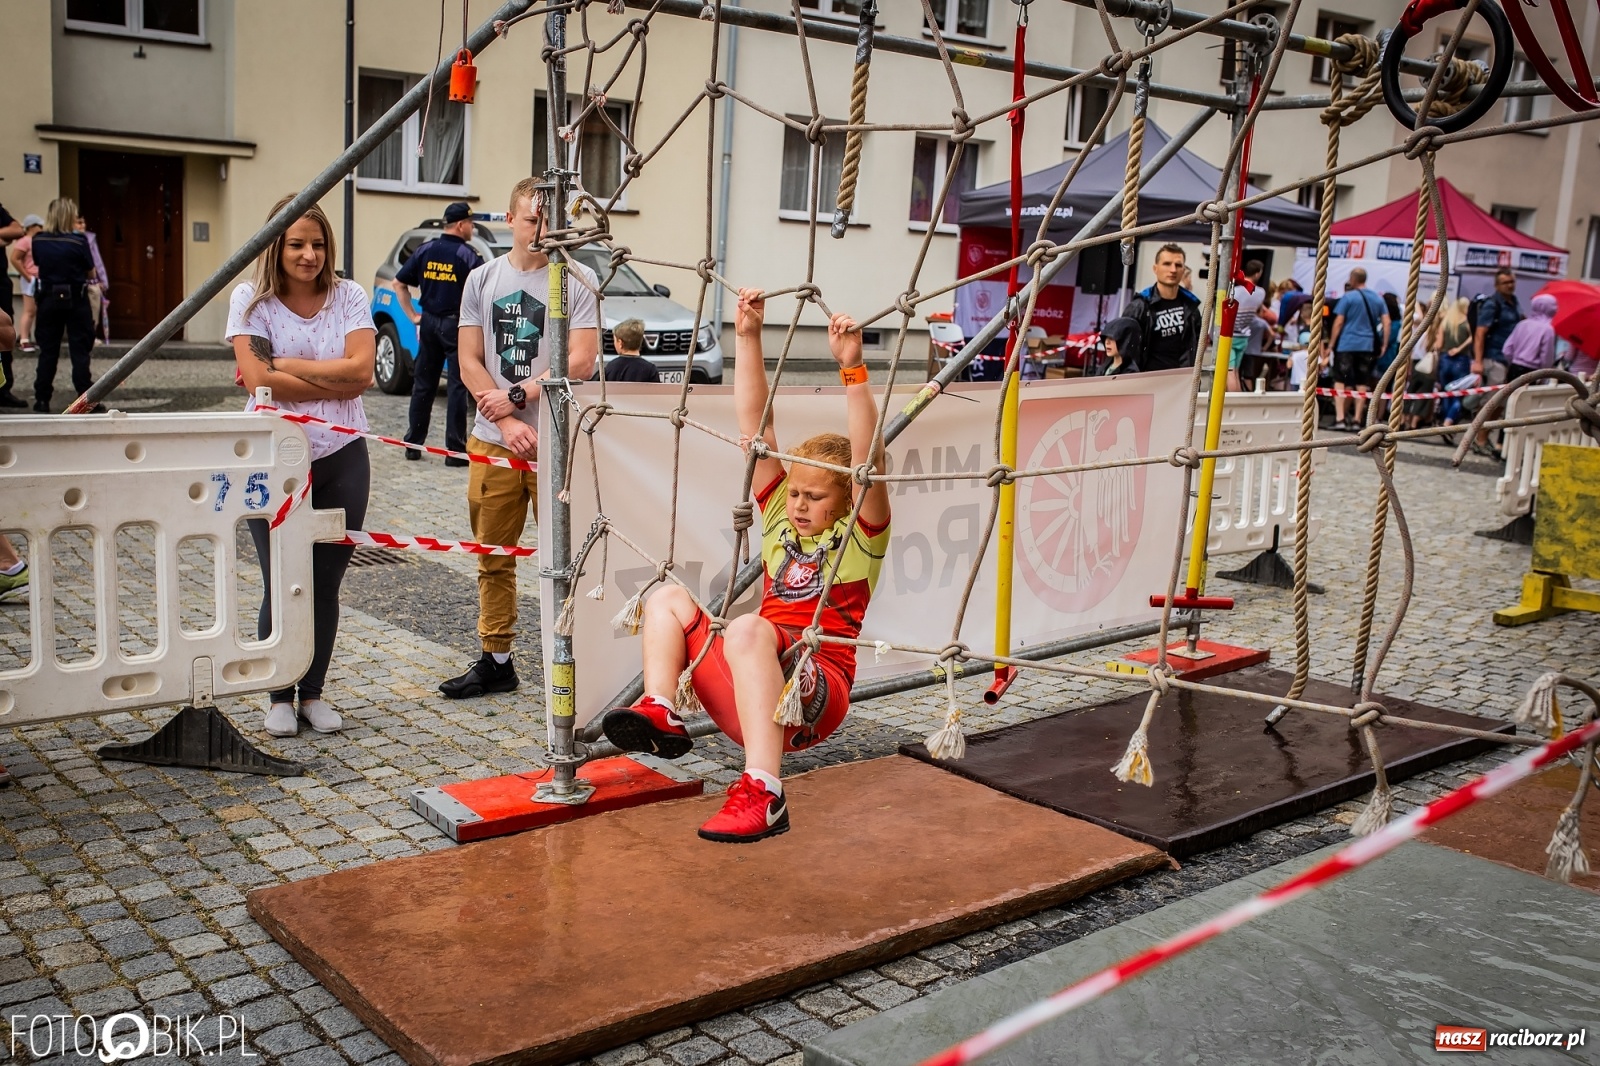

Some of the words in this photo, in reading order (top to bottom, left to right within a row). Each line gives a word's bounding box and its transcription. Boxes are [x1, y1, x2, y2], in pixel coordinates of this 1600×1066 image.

[504, 302, 522, 315] STA
[515, 317, 528, 329] RT
[1161, 326, 1177, 337] DES
[503, 333, 515, 345] TR
[510, 349, 526, 361] AIN
[514, 364, 531, 377] ING
